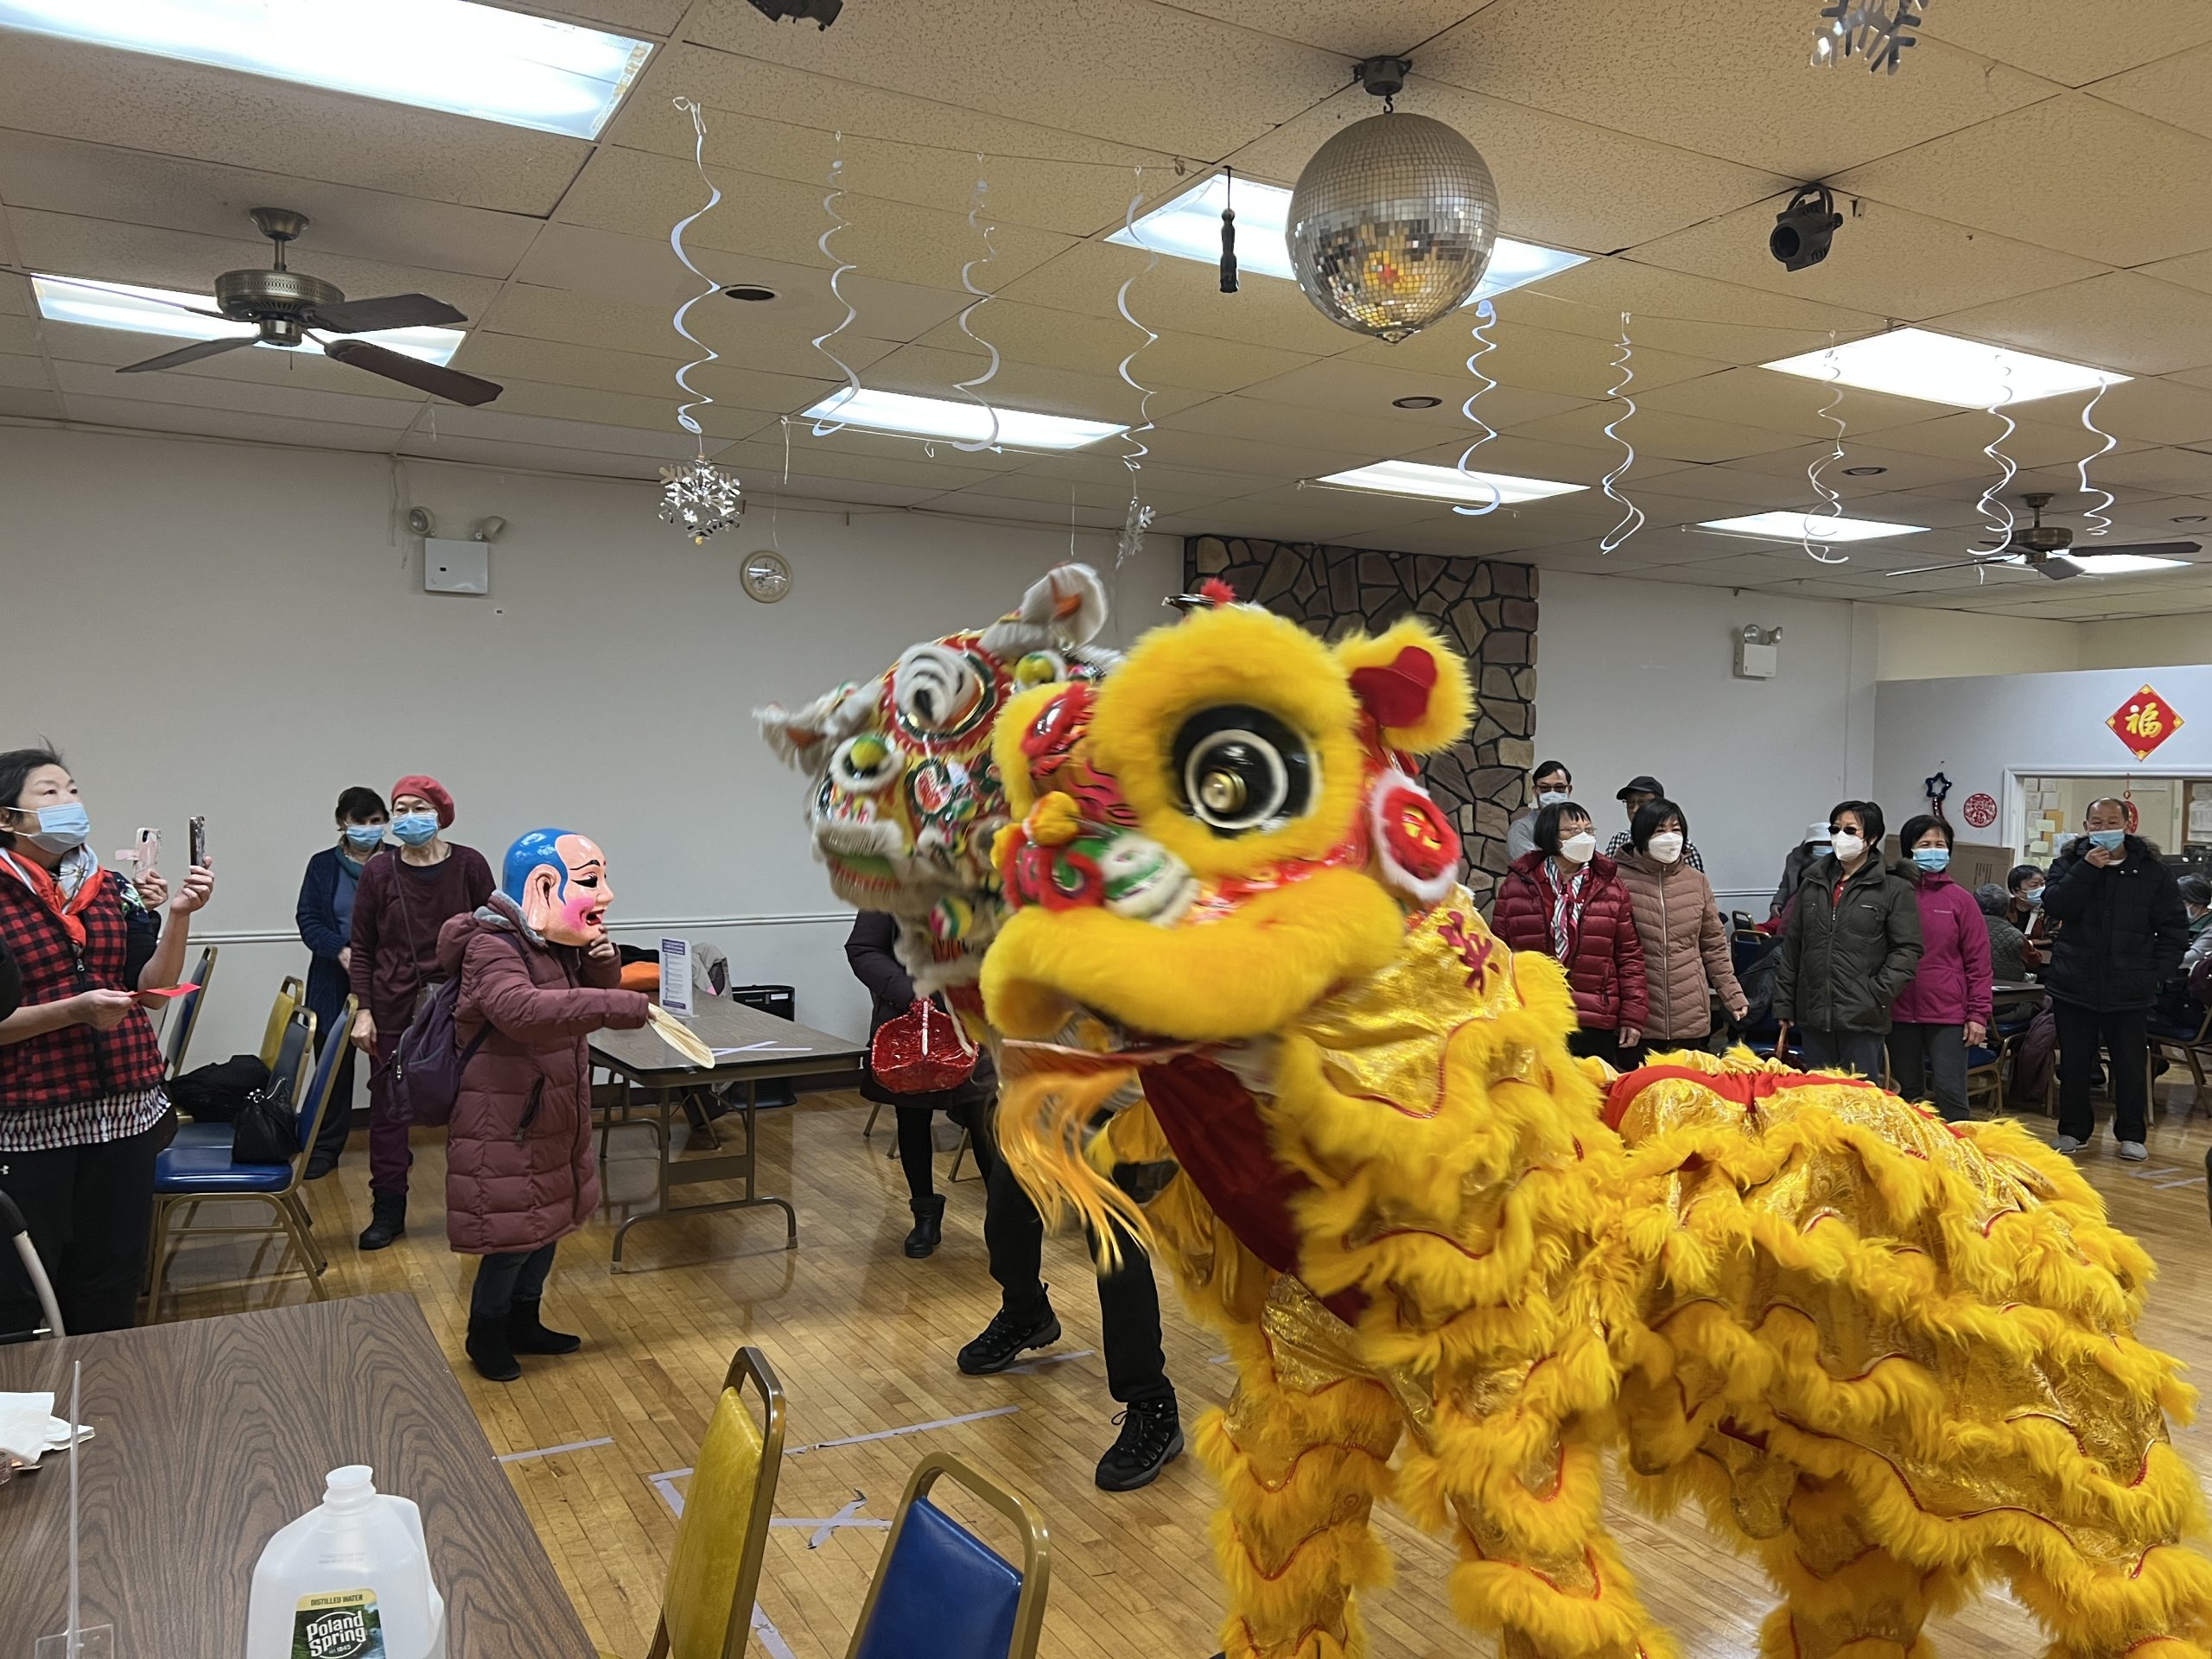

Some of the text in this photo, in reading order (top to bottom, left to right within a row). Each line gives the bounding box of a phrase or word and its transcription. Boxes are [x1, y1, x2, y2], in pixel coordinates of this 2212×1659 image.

[2125, 702, 2163, 738] 福
[311, 1594, 363, 1605] DISTILLED WATER
[306, 1611, 364, 1643] Poland
[308, 1627, 367, 1656] Spring
